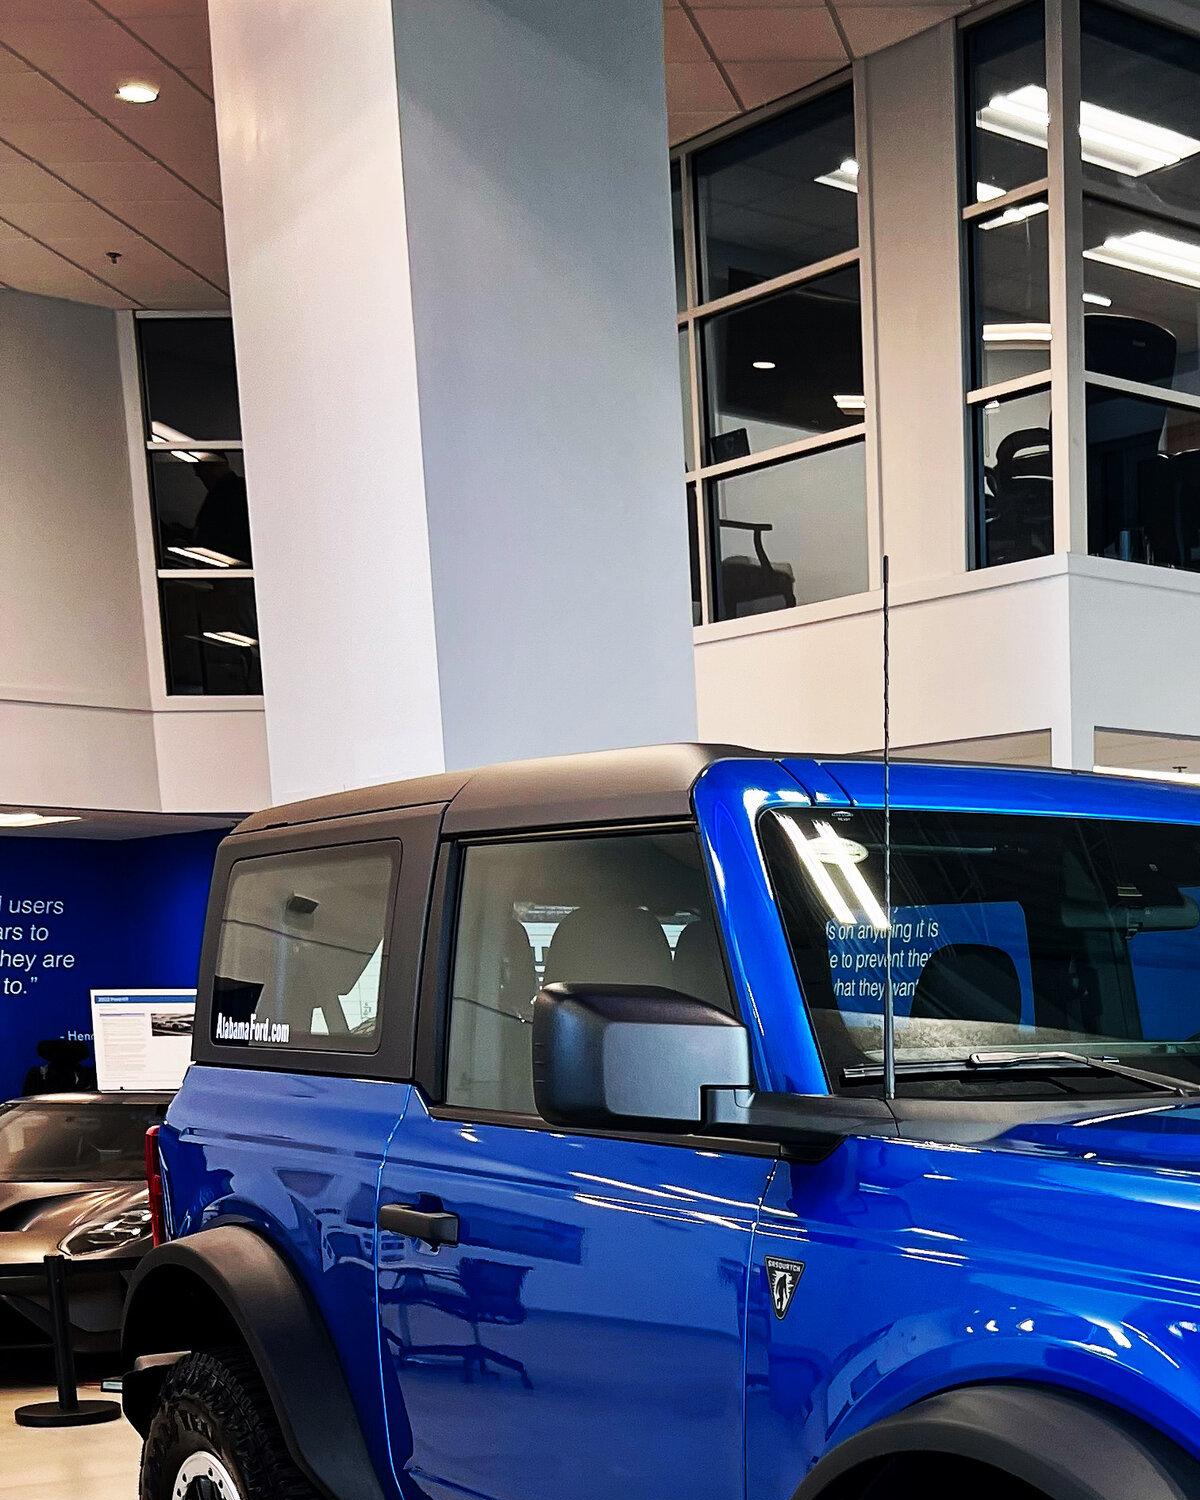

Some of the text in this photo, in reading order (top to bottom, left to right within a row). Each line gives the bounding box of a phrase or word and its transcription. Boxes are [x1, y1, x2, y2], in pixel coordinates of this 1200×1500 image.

[8, 899, 64, 915] users
[30, 924, 49, 941] to
[915, 919, 925, 938] it
[927, 918, 939, 938] is
[0, 949, 75, 972] hey are
[841, 950, 853, 969] to
[833, 978, 856, 997] hat
[858, 977, 886, 1001] they
[215, 1012, 290, 1043] AlabamaFord.com
[767, 1259, 801, 1272] SASQUATCH
